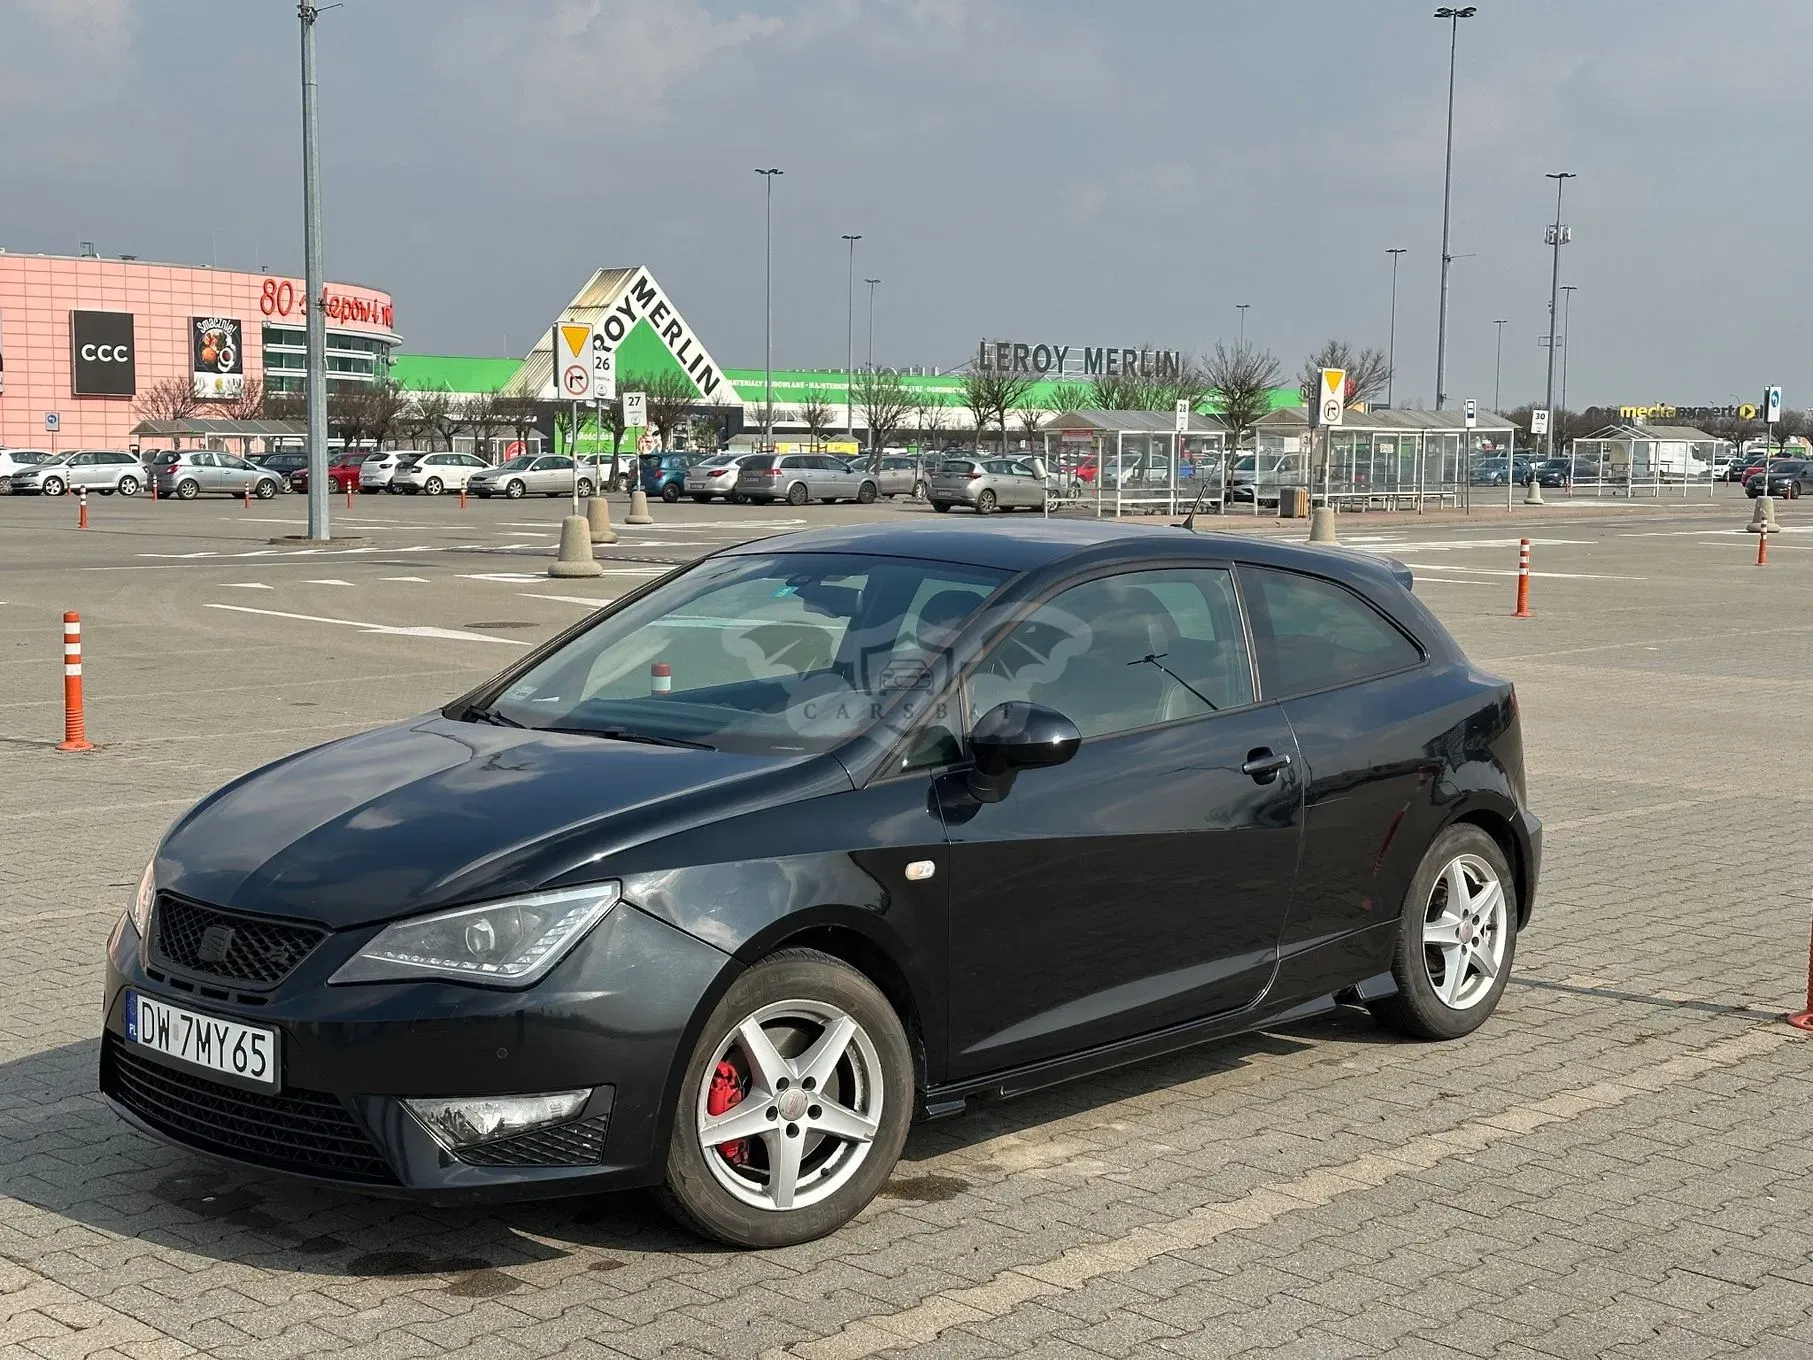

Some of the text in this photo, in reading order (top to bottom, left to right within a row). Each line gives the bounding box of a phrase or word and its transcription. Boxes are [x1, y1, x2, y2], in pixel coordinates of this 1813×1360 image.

[260, 278, 294, 317] 80
[299, 287, 370, 325] slepów
[196, 317, 238, 336] Smacznie!
[593, 275, 721, 397] ROY MERLIN
[595, 356, 610, 371] 26
[979, 341, 1181, 378] LEROY MERLIN
[628, 397, 641, 406] 27
[1179, 403, 1187, 413] 28
[1535, 412, 1546, 420] 30
[129, 1023, 137, 1036] PL
[142, 1001, 266, 1077] DW 7MY65
